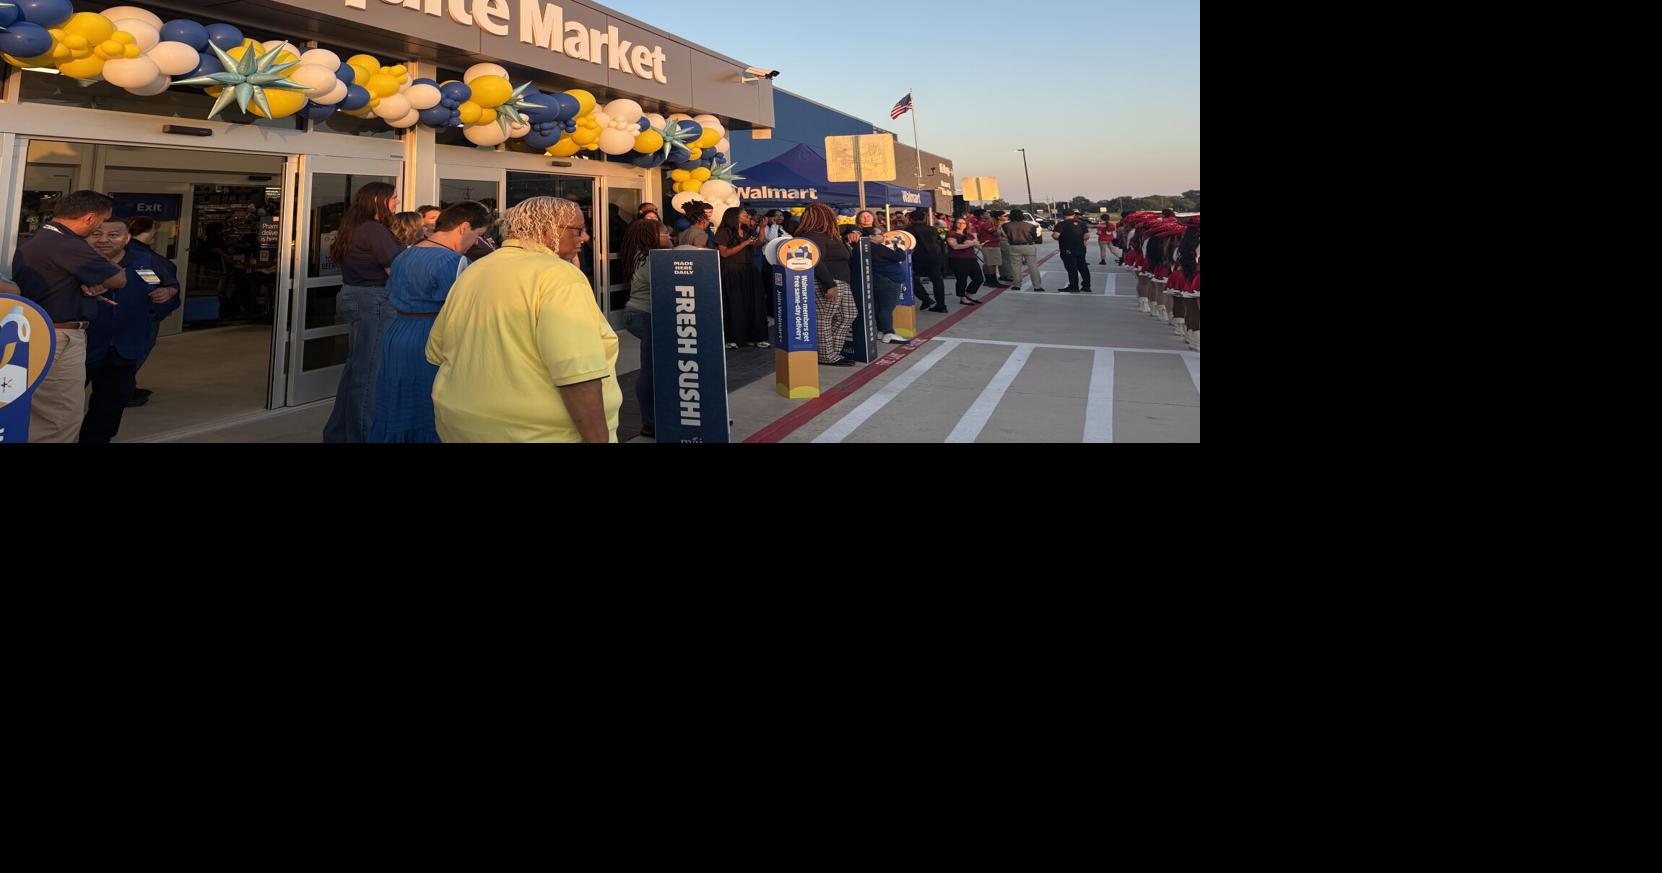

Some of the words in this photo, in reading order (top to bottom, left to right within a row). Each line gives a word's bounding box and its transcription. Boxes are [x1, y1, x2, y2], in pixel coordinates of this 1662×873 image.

[519, 0, 668, 85] Market
[735, 186, 818, 200] Walmart
[137, 202, 162, 212] Exit
[674, 285, 698, 354] FRESH
[795, 316, 803, 341] delivery
[802, 303, 810, 331] members
[802, 332, 810, 342] get
[678, 360, 701, 427] SUSHI
